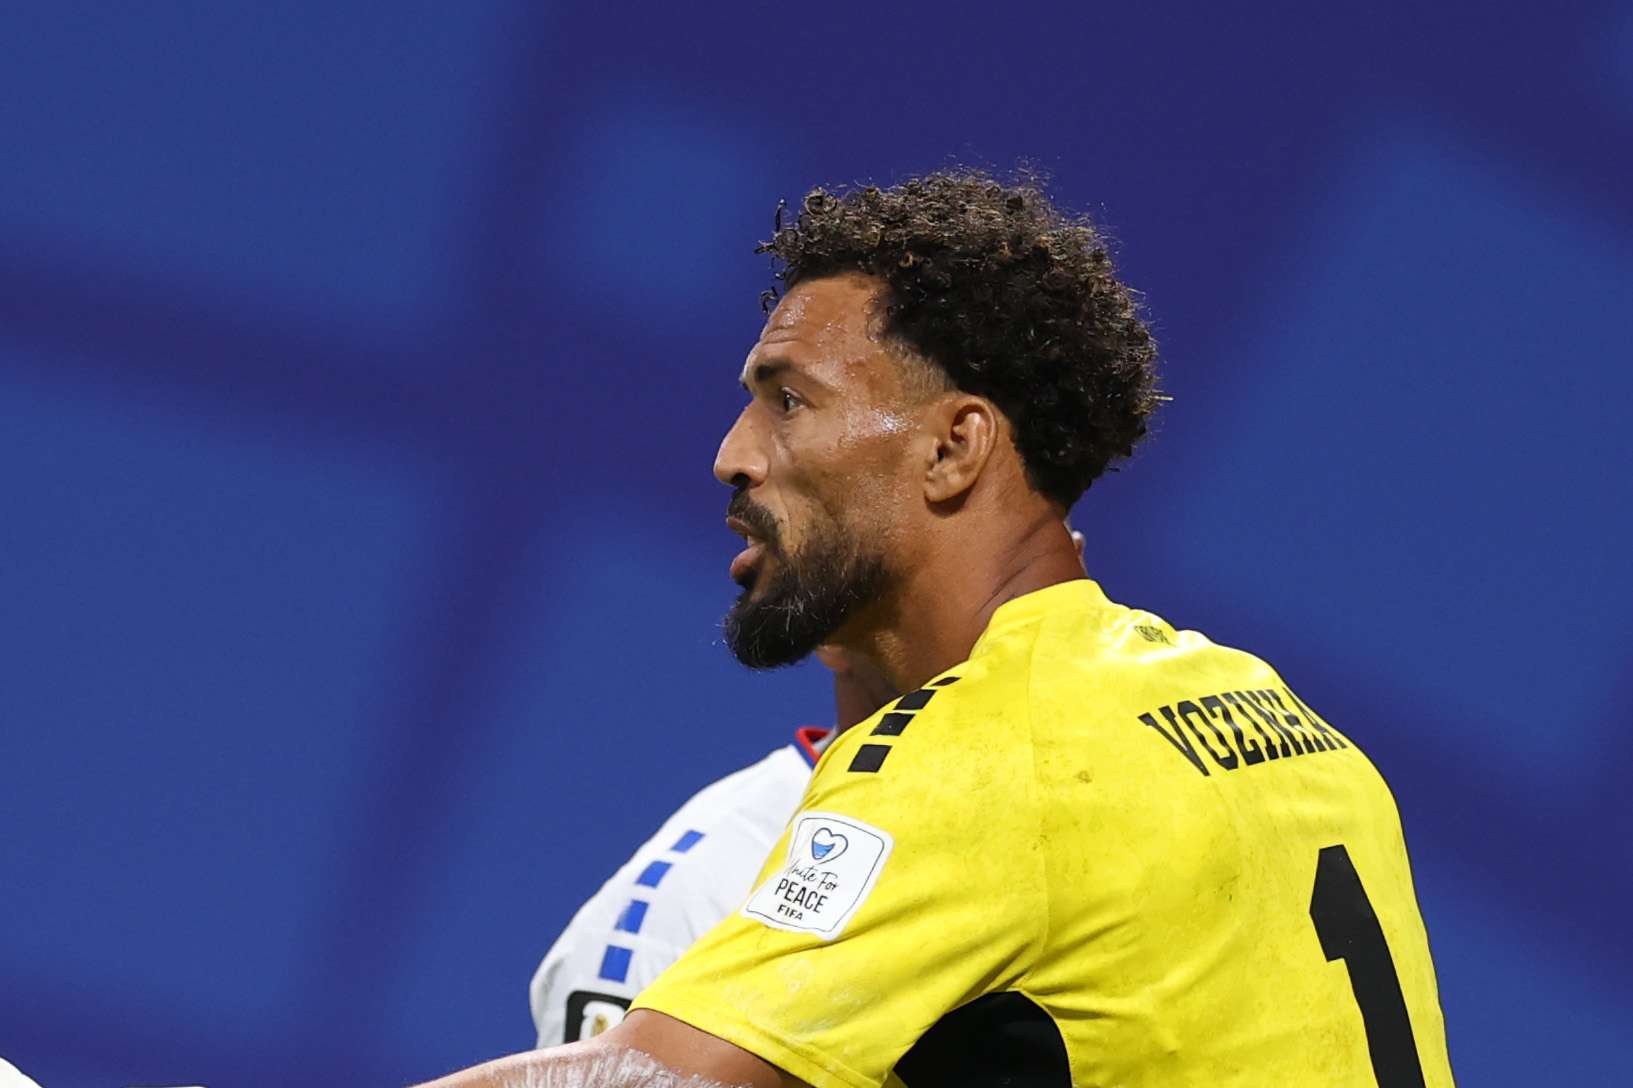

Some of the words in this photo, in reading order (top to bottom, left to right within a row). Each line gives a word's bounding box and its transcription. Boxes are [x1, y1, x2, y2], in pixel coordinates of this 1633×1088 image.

[818, 871, 839, 891] For
[774, 878, 829, 914] PEACE
[777, 904, 804, 921] FIFA
